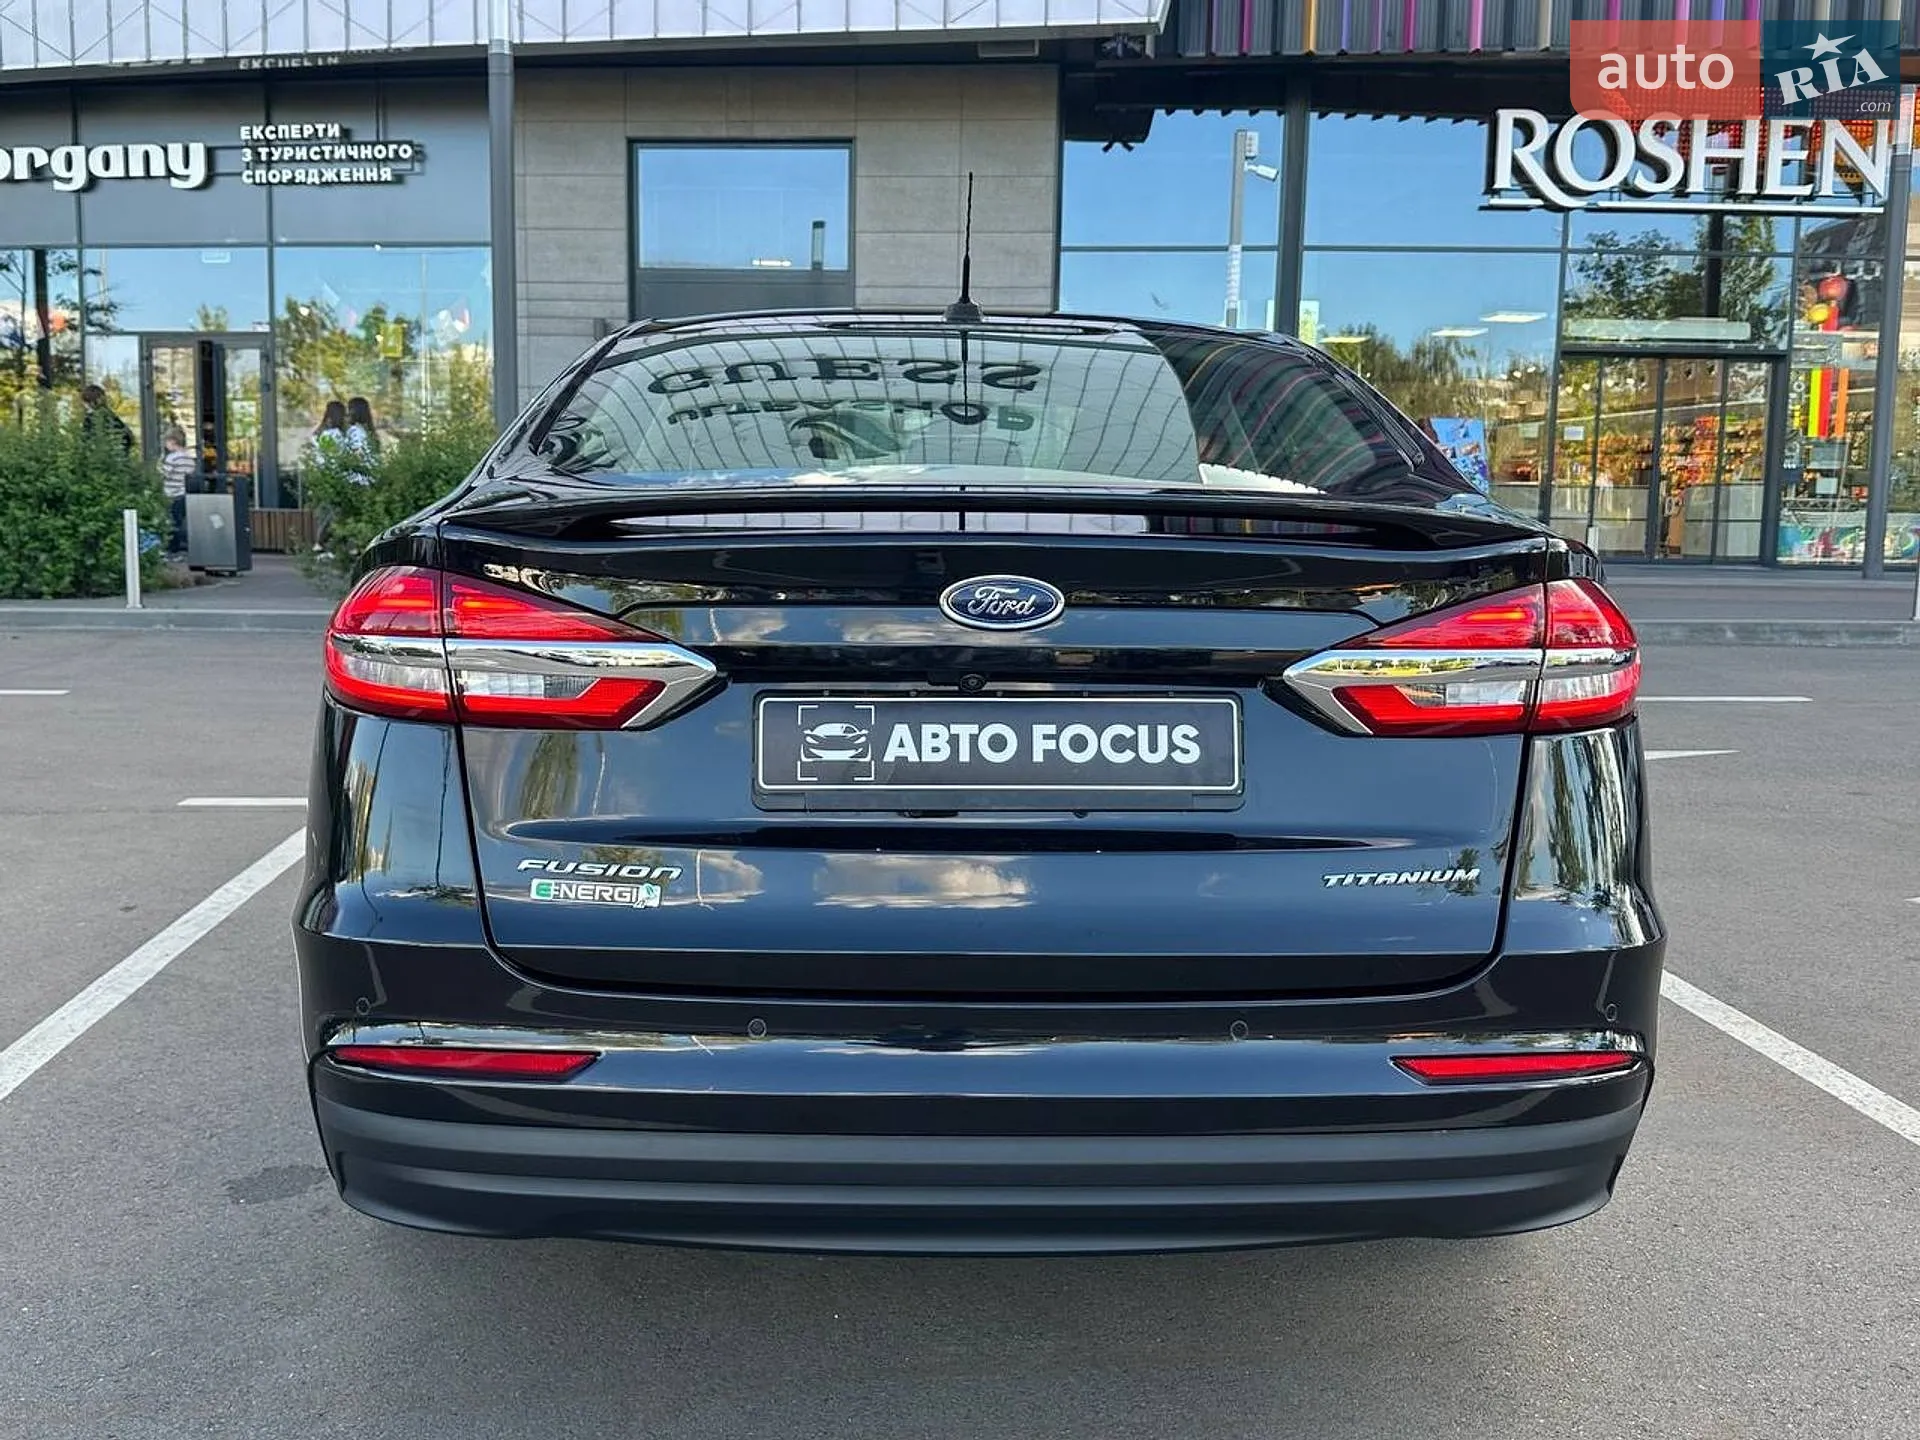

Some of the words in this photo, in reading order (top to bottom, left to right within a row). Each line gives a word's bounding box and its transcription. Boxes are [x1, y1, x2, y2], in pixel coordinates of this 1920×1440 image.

[240, 123, 341, 140] ЕКСПЕРТИ
[257, 143, 413, 162] ТУРИСТИЧНОГО
[1493, 108, 1890, 208] ROSHEN
[241, 167, 393, 185] СПОРЯДЖЕННЯ
[967, 585, 1035, 617] Ford
[882, 723, 1018, 763] АВТО
[1032, 723, 1200, 763] FOCUS
[517, 858, 683, 880] FUSION
[1323, 868, 1481, 888] TITANIUM
[535, 881, 639, 903] ENERGI
